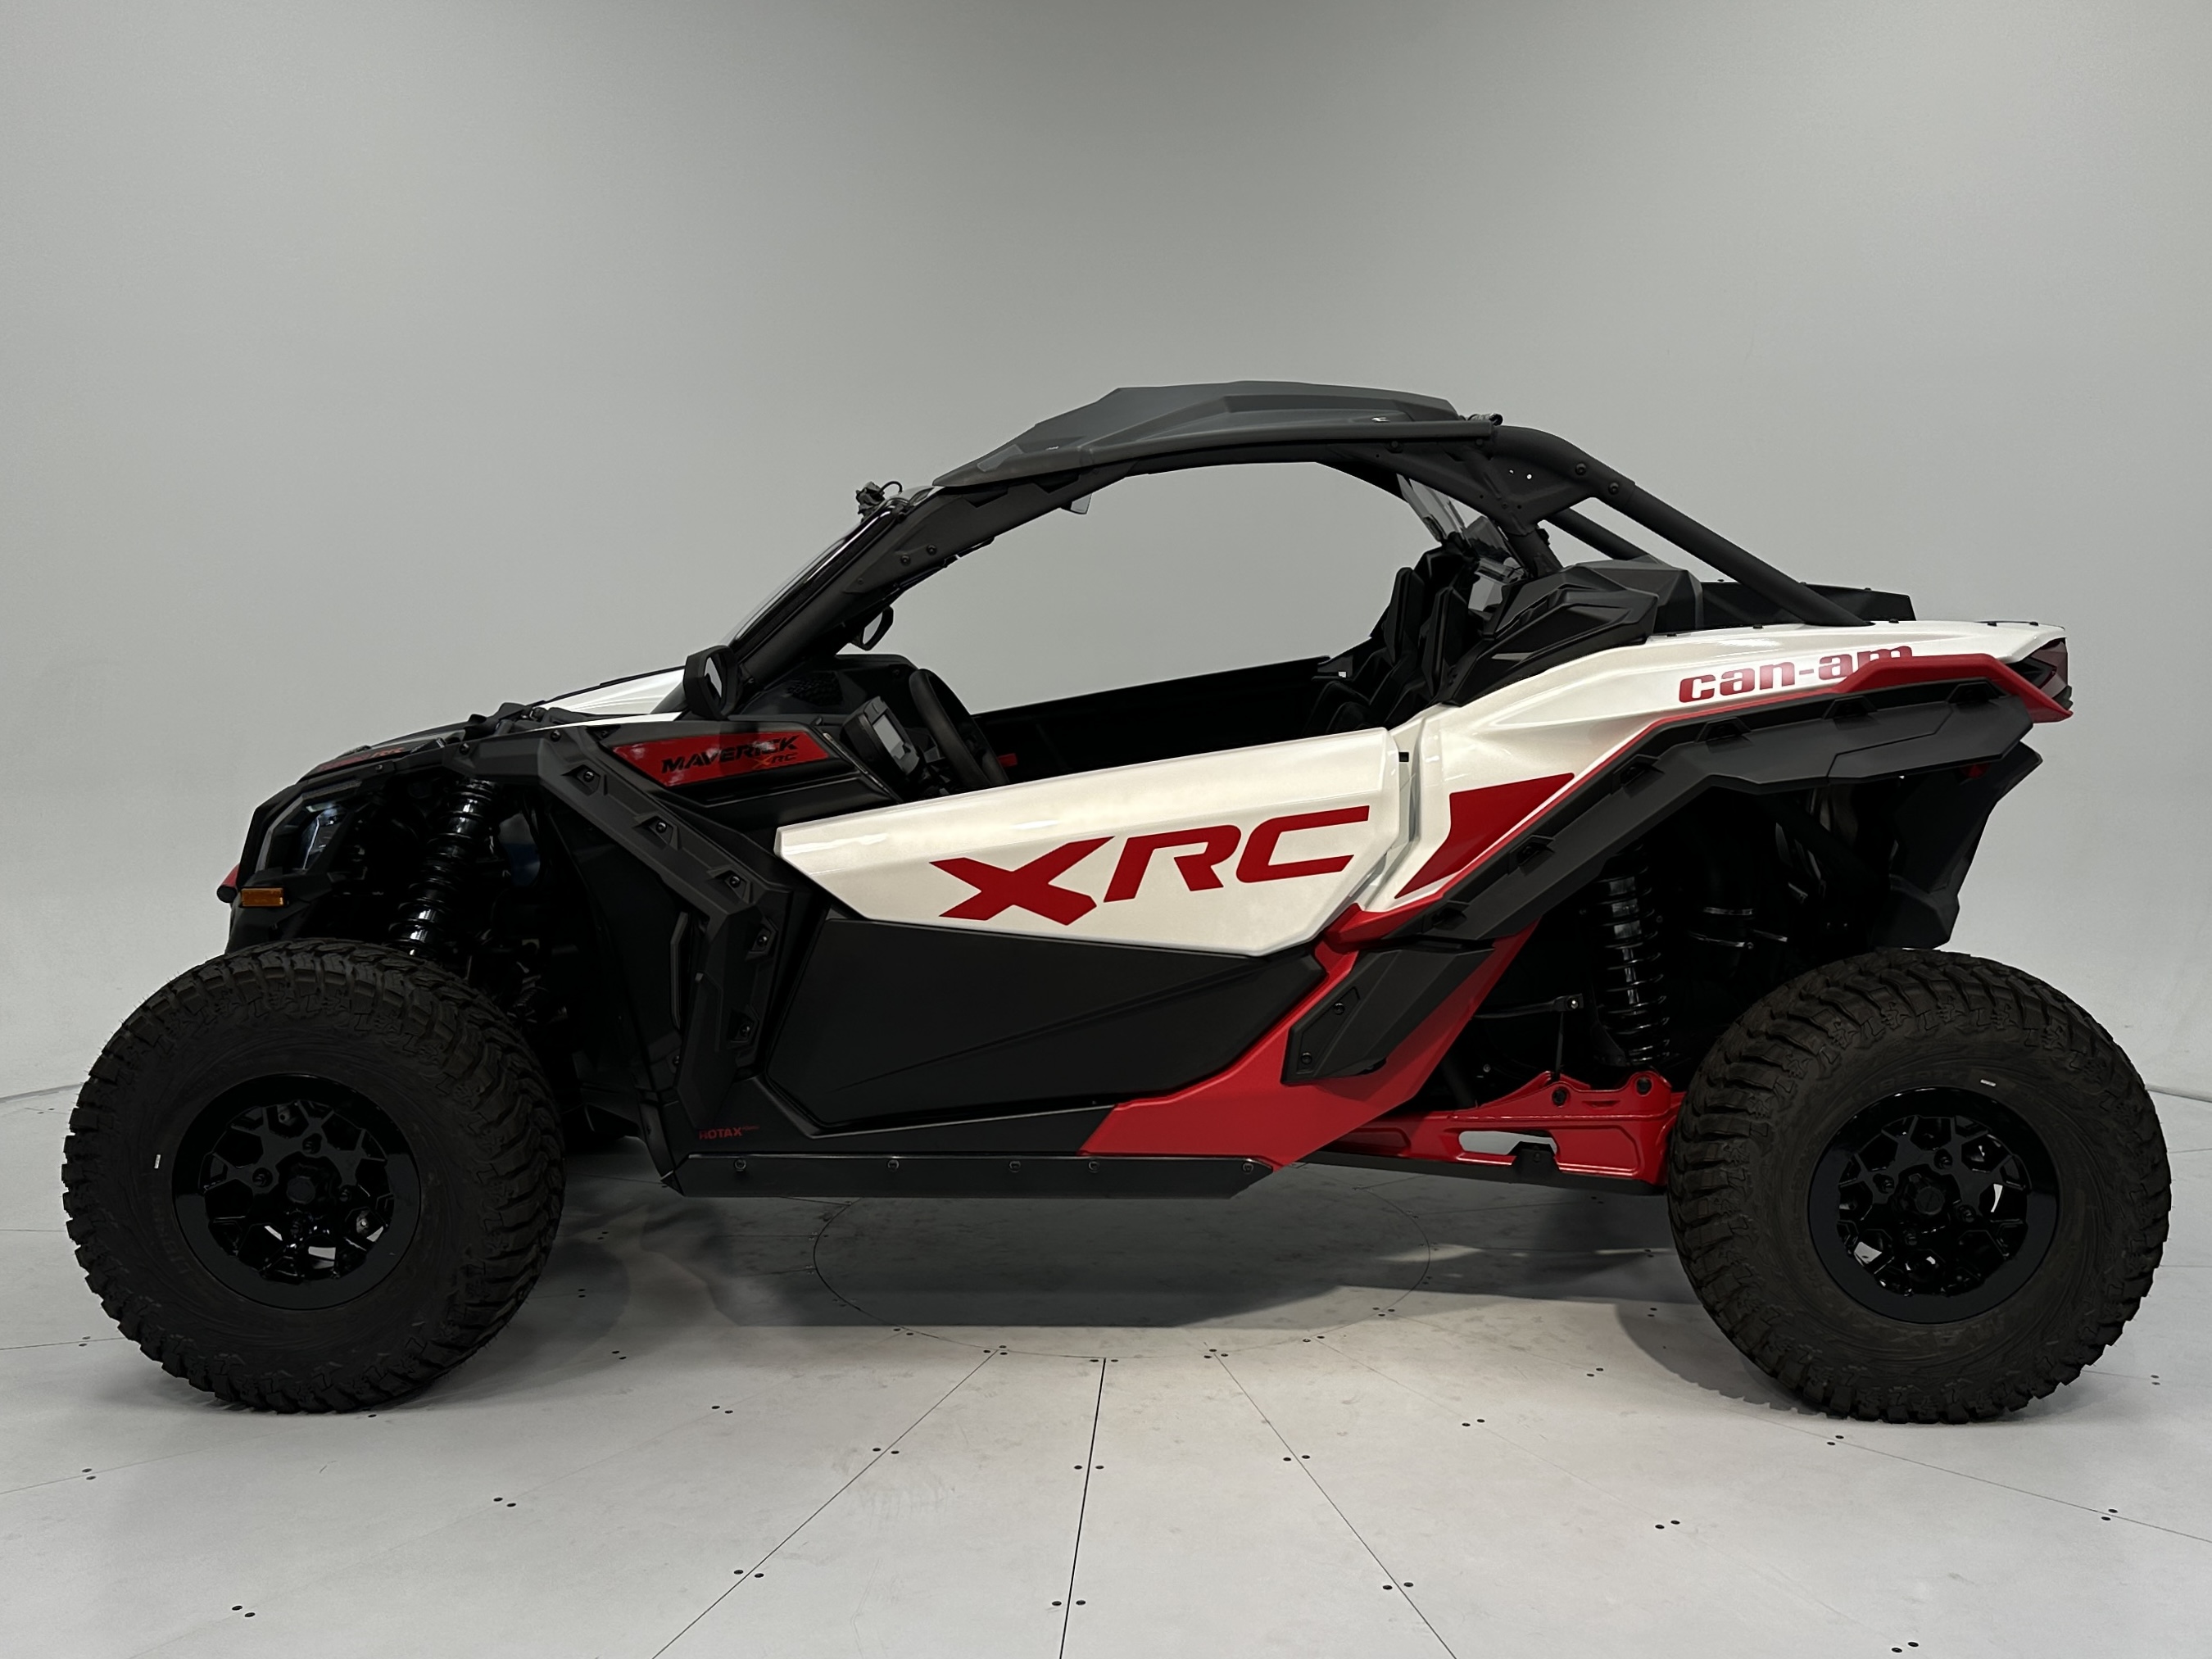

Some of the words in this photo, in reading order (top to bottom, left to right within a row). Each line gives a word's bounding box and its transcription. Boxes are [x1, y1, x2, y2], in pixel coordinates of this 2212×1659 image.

[661, 734, 800, 773] MAVERICK
[928, 805, 1371, 927] XRC
[697, 1126, 744, 1141] ROTAX
